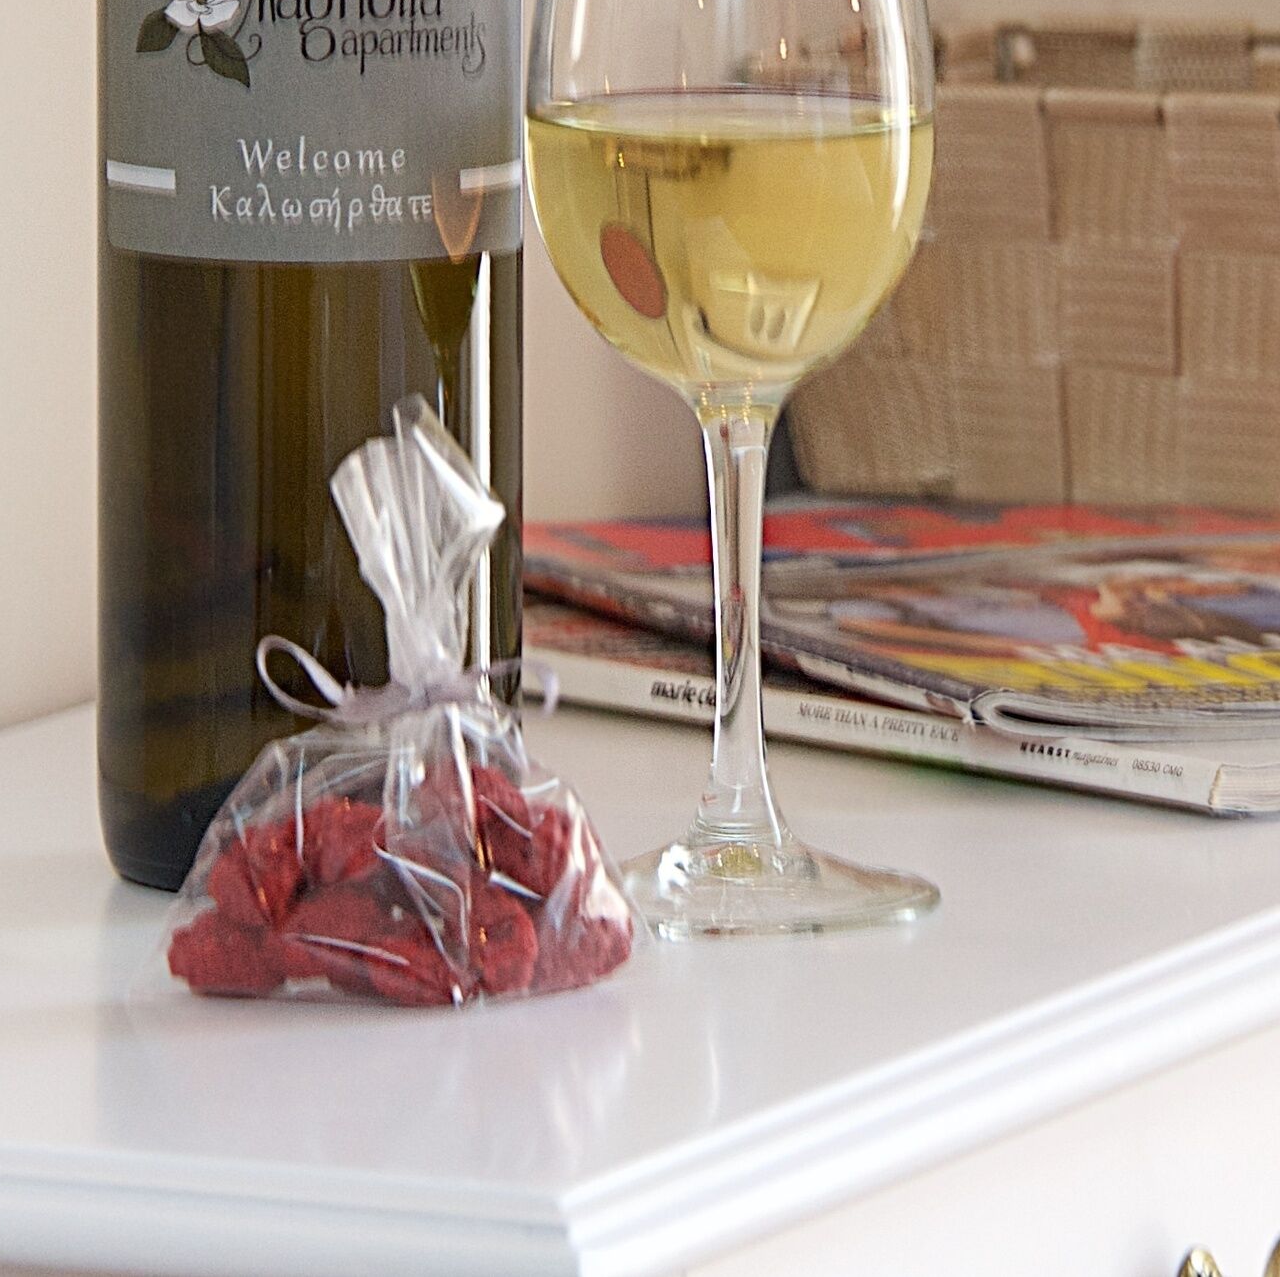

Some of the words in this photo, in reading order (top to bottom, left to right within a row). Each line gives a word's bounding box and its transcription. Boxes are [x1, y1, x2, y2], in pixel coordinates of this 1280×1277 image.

[341, 10, 486, 78] apartments
[237, 135, 406, 171] Welcome
[209, 183, 432, 230] Καλωσήρθατε
[651, 679, 697, 703] marie
[698, 684, 717, 707] cla
[798, 702, 832, 721] MORE
[834, 708, 867, 729] THAN
[870, 715, 879, 730] A
[882, 716, 926, 738] PRETTY
[930, 725, 959, 742] FACE
[1020, 741, 1070, 758] HEARST
